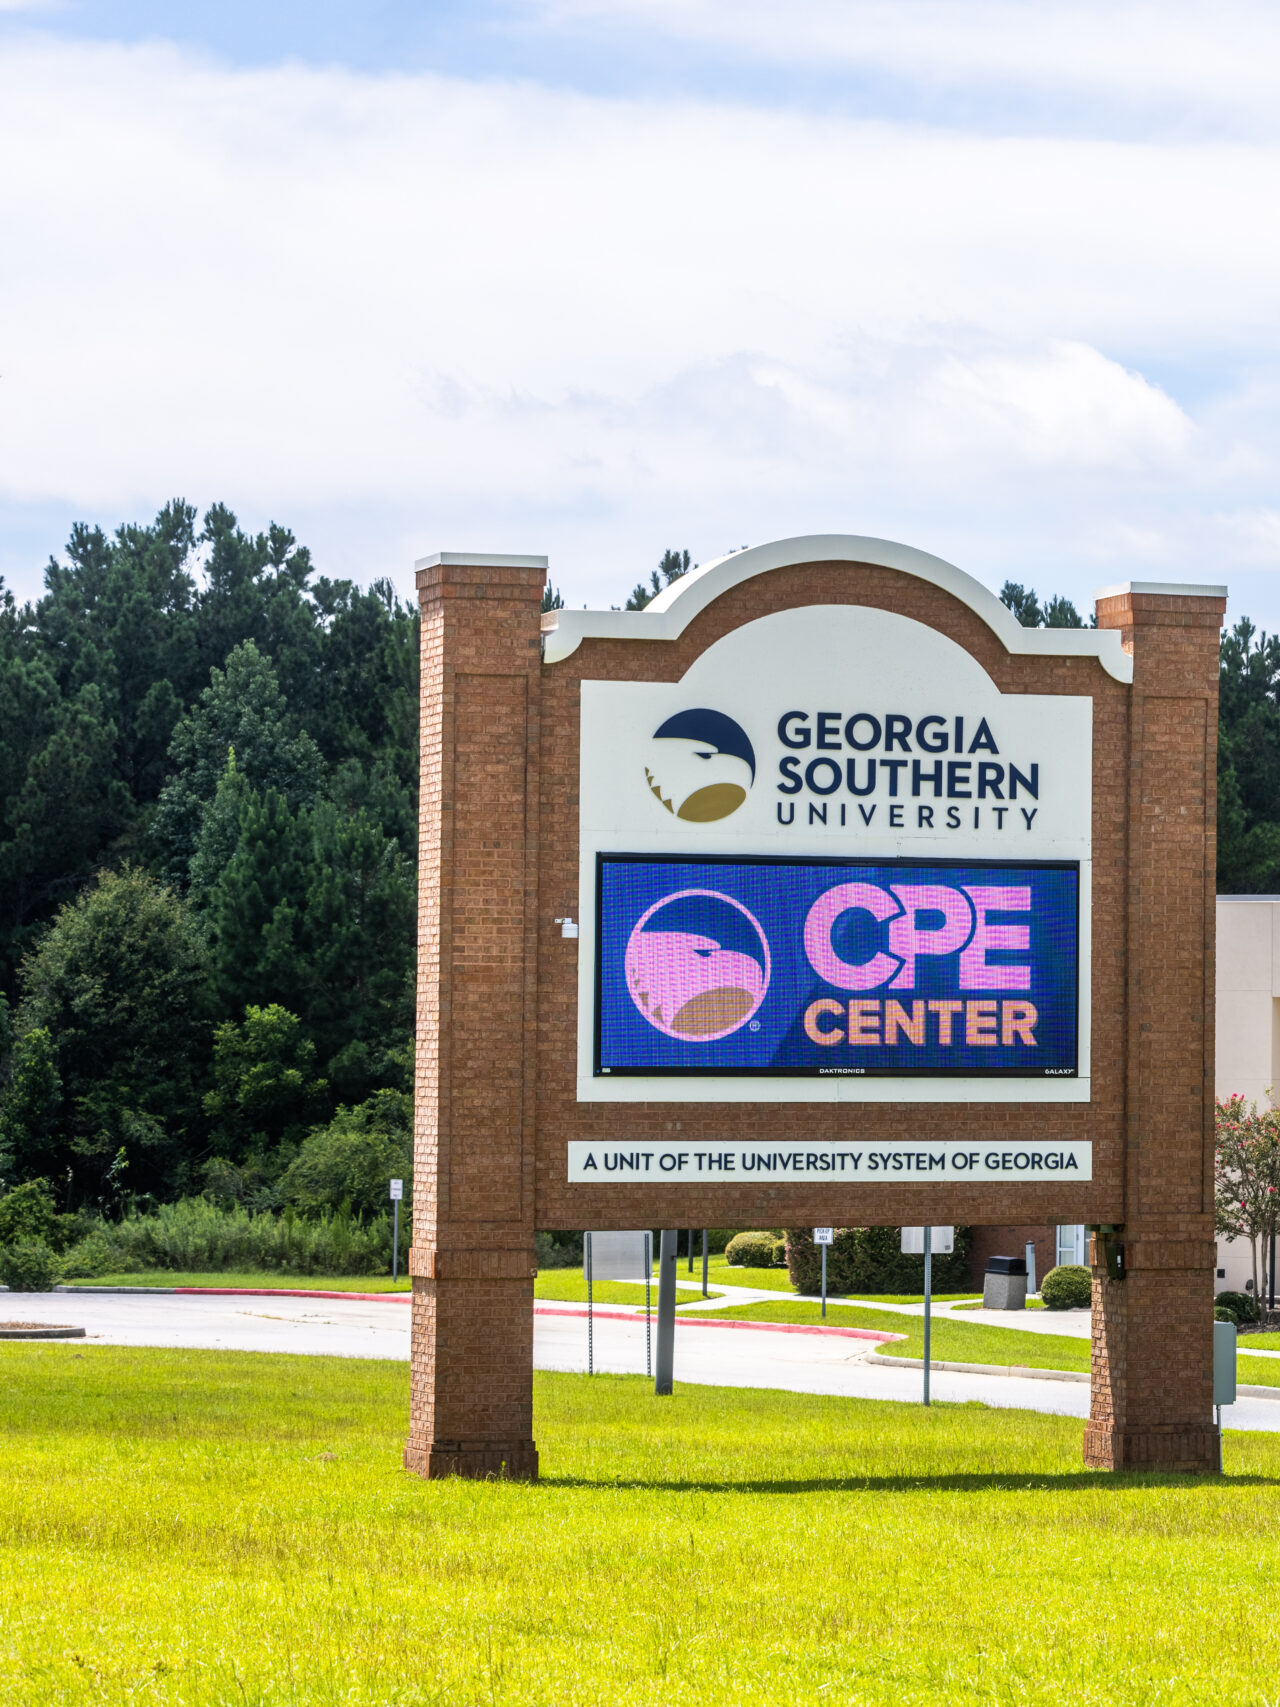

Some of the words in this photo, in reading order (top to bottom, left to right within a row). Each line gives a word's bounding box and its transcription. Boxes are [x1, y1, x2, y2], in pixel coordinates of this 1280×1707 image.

[777, 711, 999, 754] GEORGIA
[777, 756, 1039, 801] SOUTHERN
[777, 802, 1038, 831] UNIVERSITY
[803, 882, 1031, 990] CPE
[803, 998, 1038, 1046] CENTER
[583, 1152, 598, 1171] A
[604, 1153, 654, 1171] UNIT
[659, 1153, 689, 1171] OF
[694, 1153, 735, 1171] THE
[742, 1153, 863, 1171] UNIVERSITY
[867, 1152, 945, 1171] SYSTEM
[951, 1152, 980, 1170] OF
[984, 1152, 1078, 1170] GEORGIA
